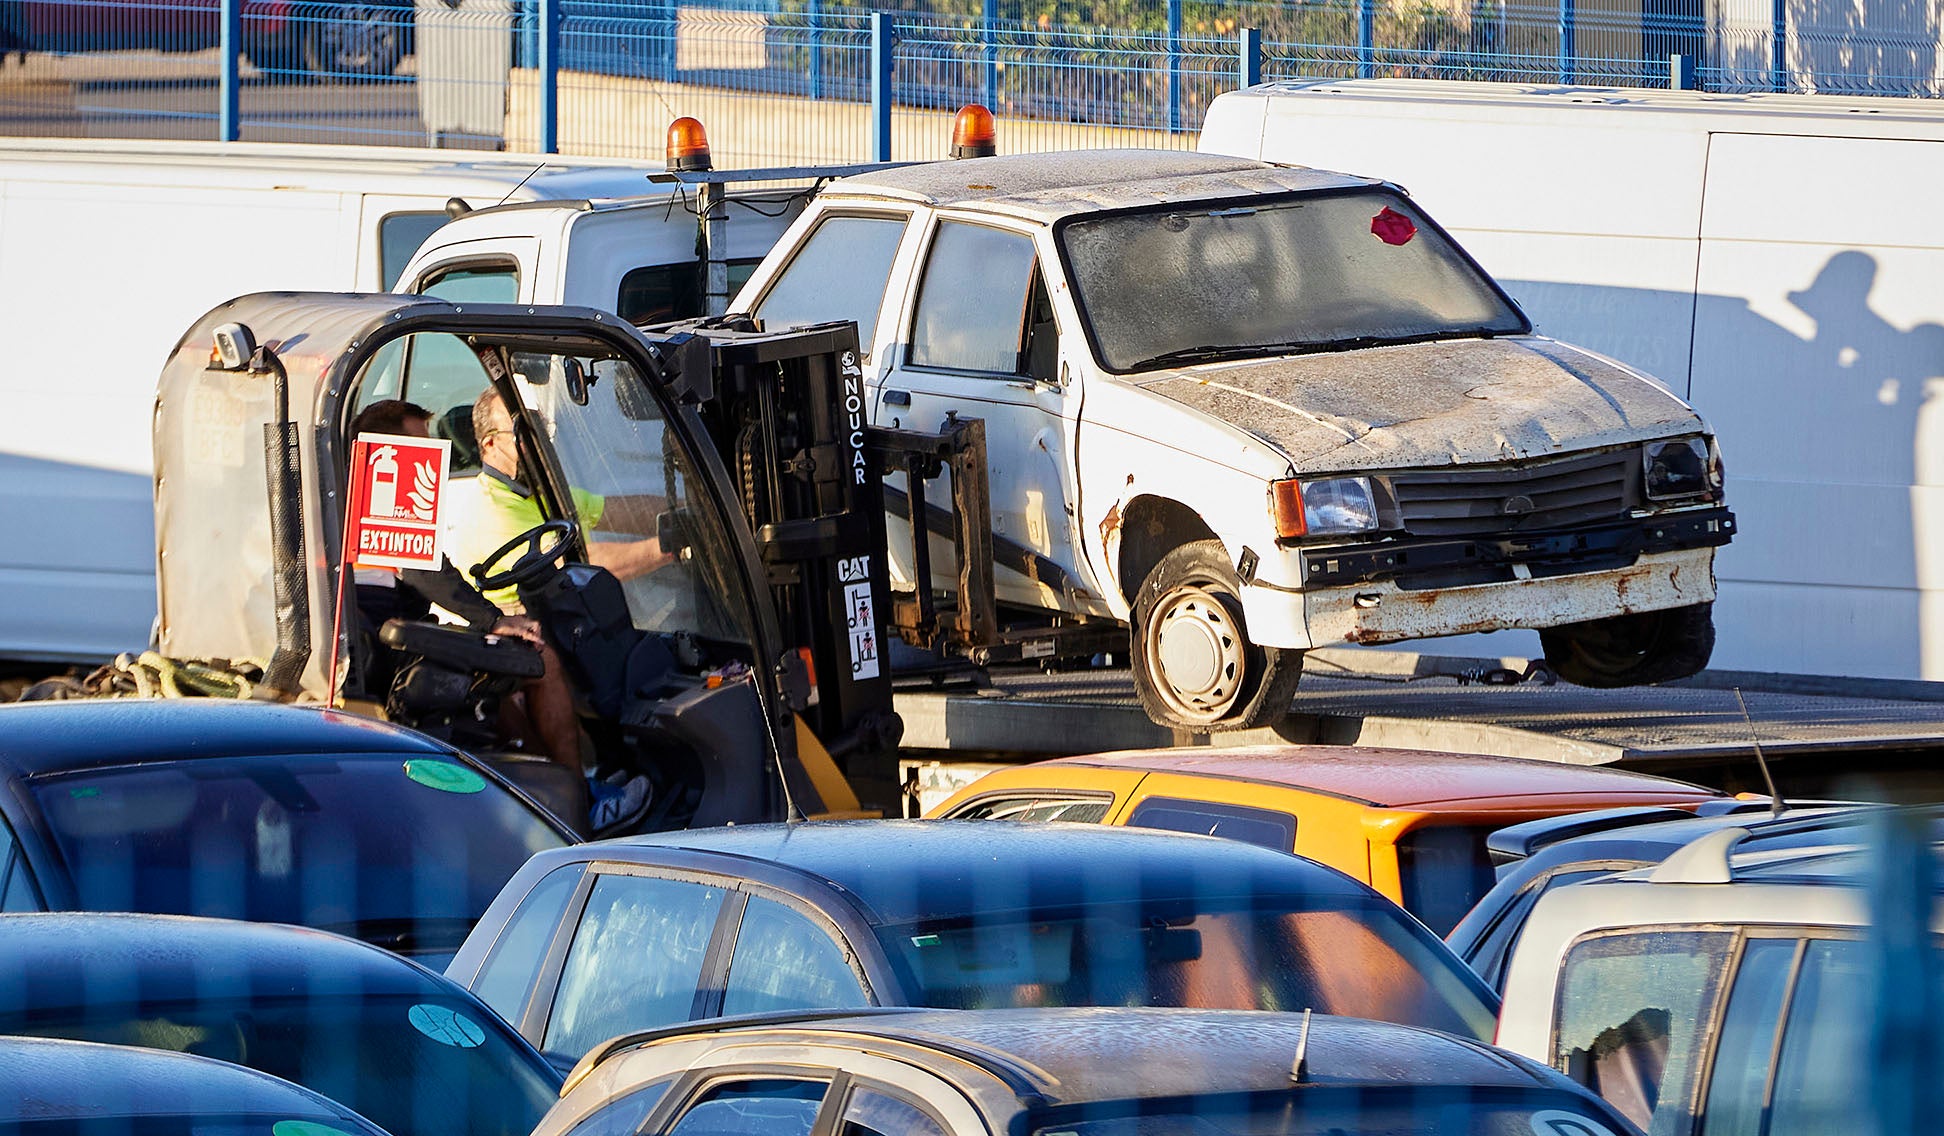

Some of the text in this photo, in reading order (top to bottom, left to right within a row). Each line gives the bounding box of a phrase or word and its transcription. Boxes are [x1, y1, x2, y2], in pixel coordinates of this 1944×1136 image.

[844, 377, 866, 485] NOUCAR
[360, 529, 434, 555] EXTINTOR
[838, 555, 870, 582] CAT
